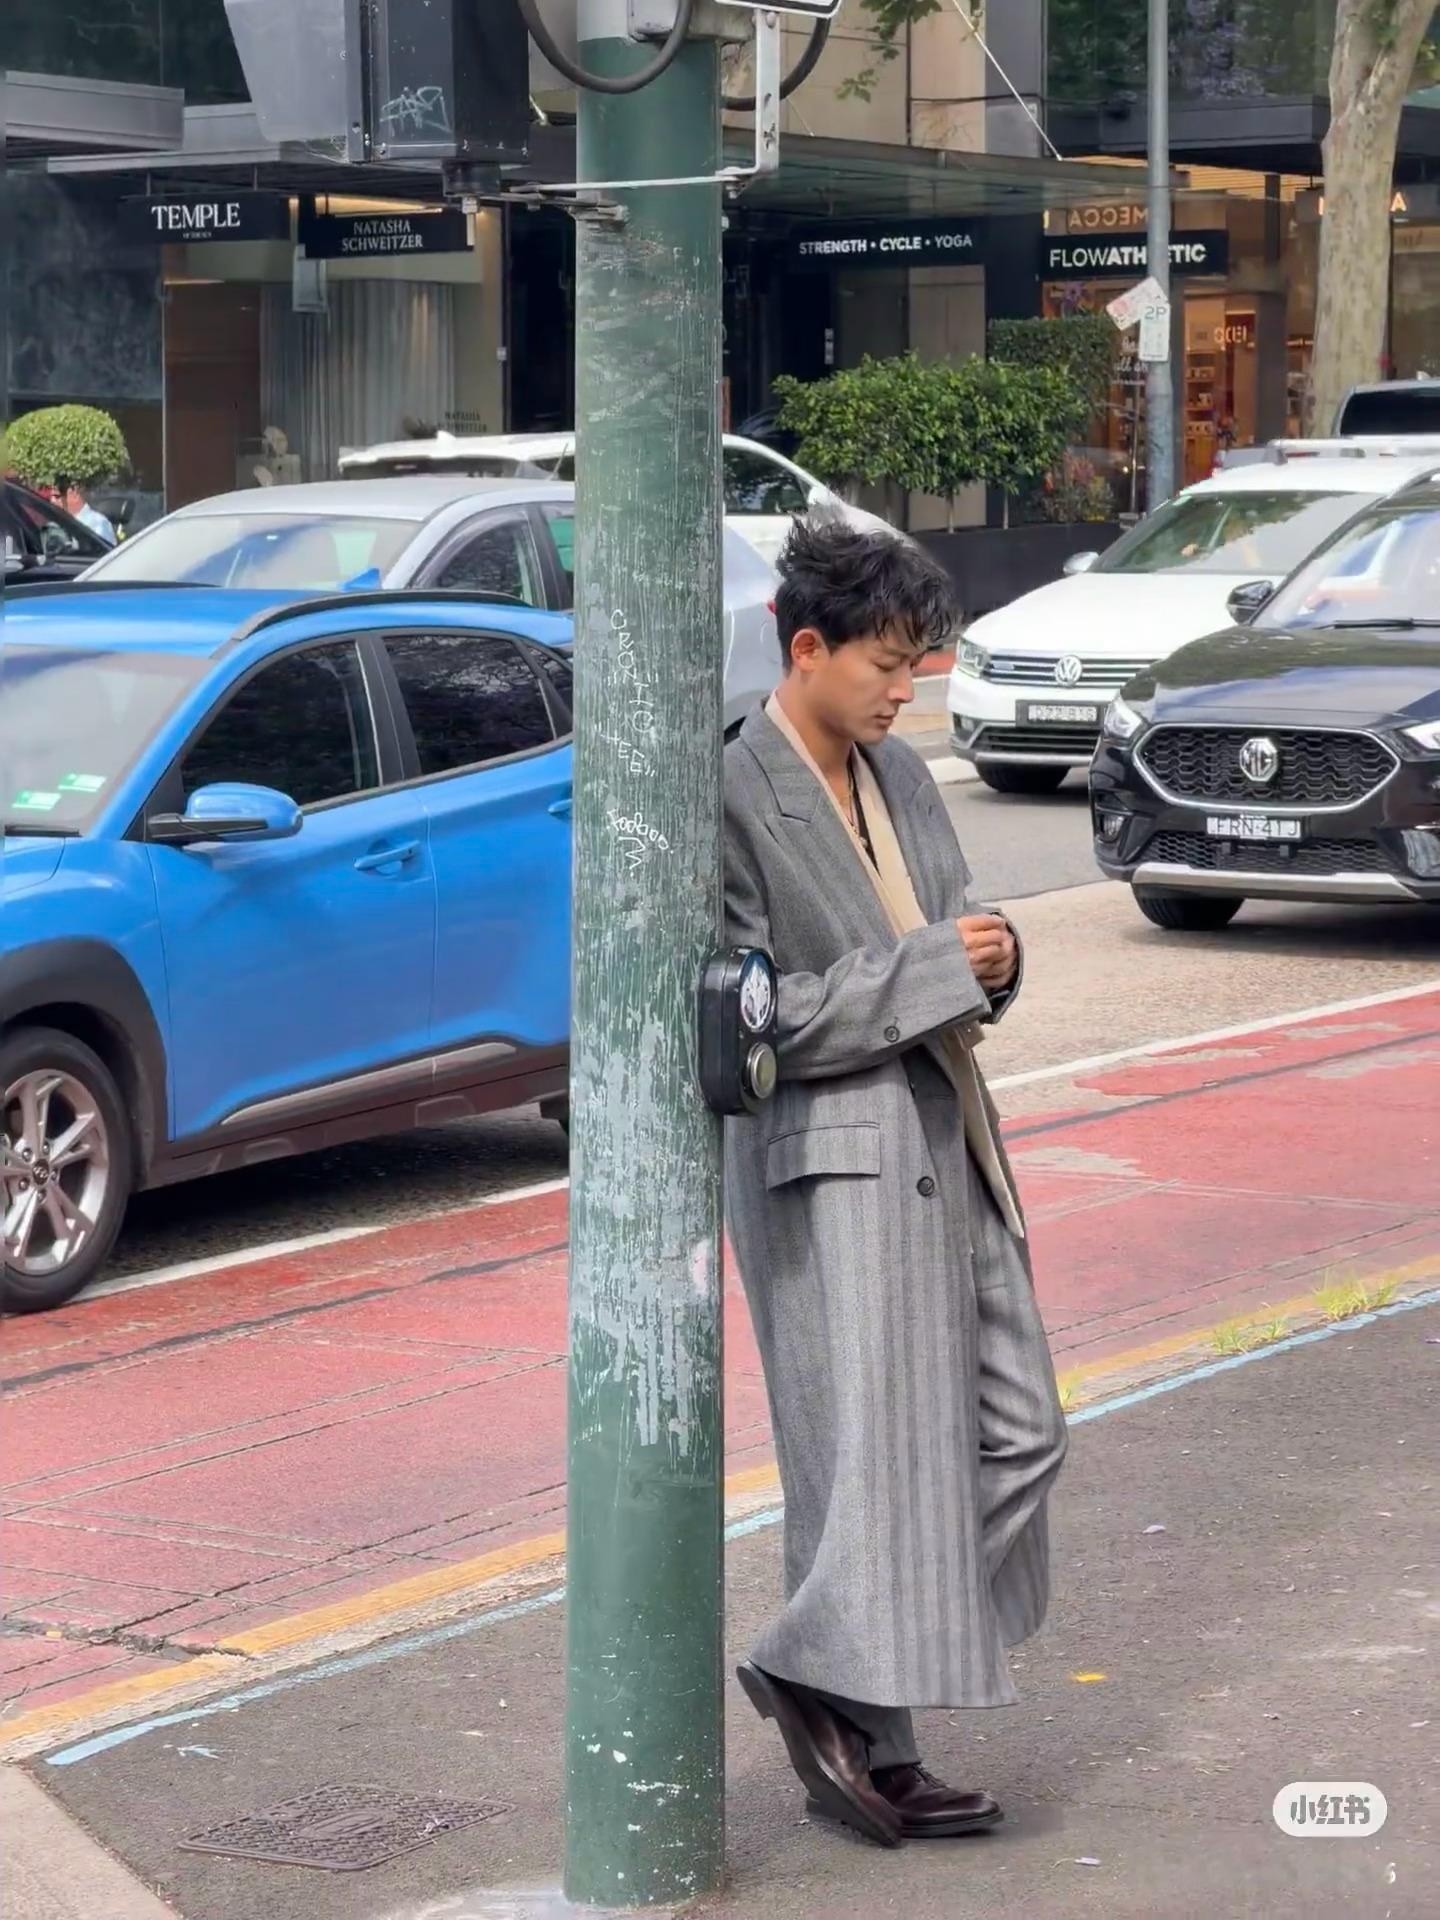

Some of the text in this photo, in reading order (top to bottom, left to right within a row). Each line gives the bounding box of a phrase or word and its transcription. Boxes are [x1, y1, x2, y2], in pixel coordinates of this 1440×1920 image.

[151, 203, 241, 230] TEMPLE
[353, 219, 411, 235] NATASHA
[342, 234, 423, 251] SCHWEITZER
[799, 234, 973, 255] STRENGTH CYCLE YOGA
[1049, 243, 1207, 268] FLOWATHTIC
[1144, 305, 1168, 321] 2P
[1240, 738, 1278, 781] MG
